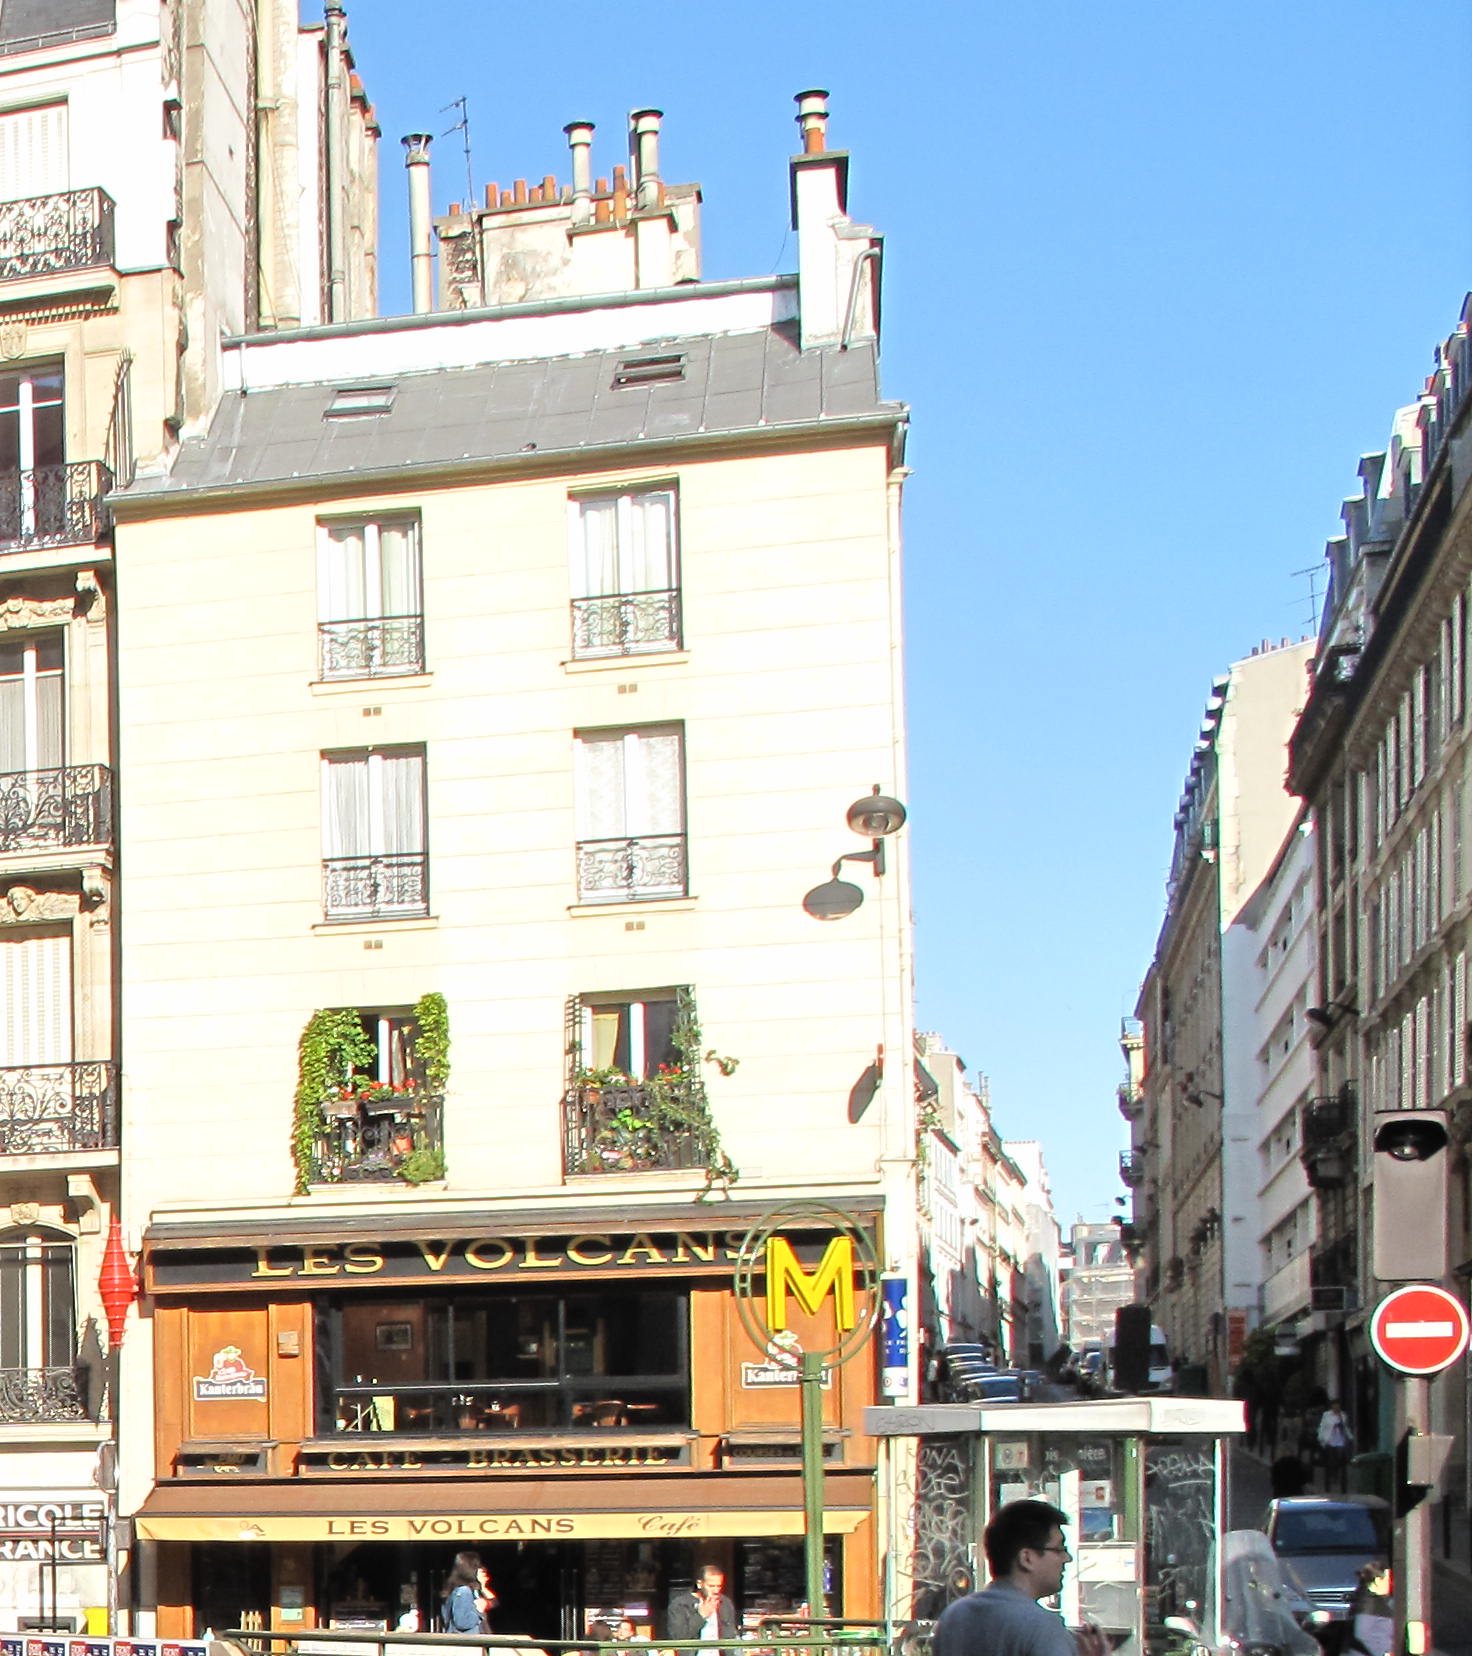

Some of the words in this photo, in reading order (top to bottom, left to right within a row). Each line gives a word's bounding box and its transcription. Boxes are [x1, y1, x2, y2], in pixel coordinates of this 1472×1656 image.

[251, 1242, 386, 1278] LES
[419, 1232, 767, 1272] VOLCANS
[766, 1236, 855, 1331] M
[466, 1446, 669, 1469] BRASSERIE
[326, 1520, 390, 1536] LES
[409, 1518, 575, 1535] VOLCANS
[637, 1515, 700, 1536] Café
